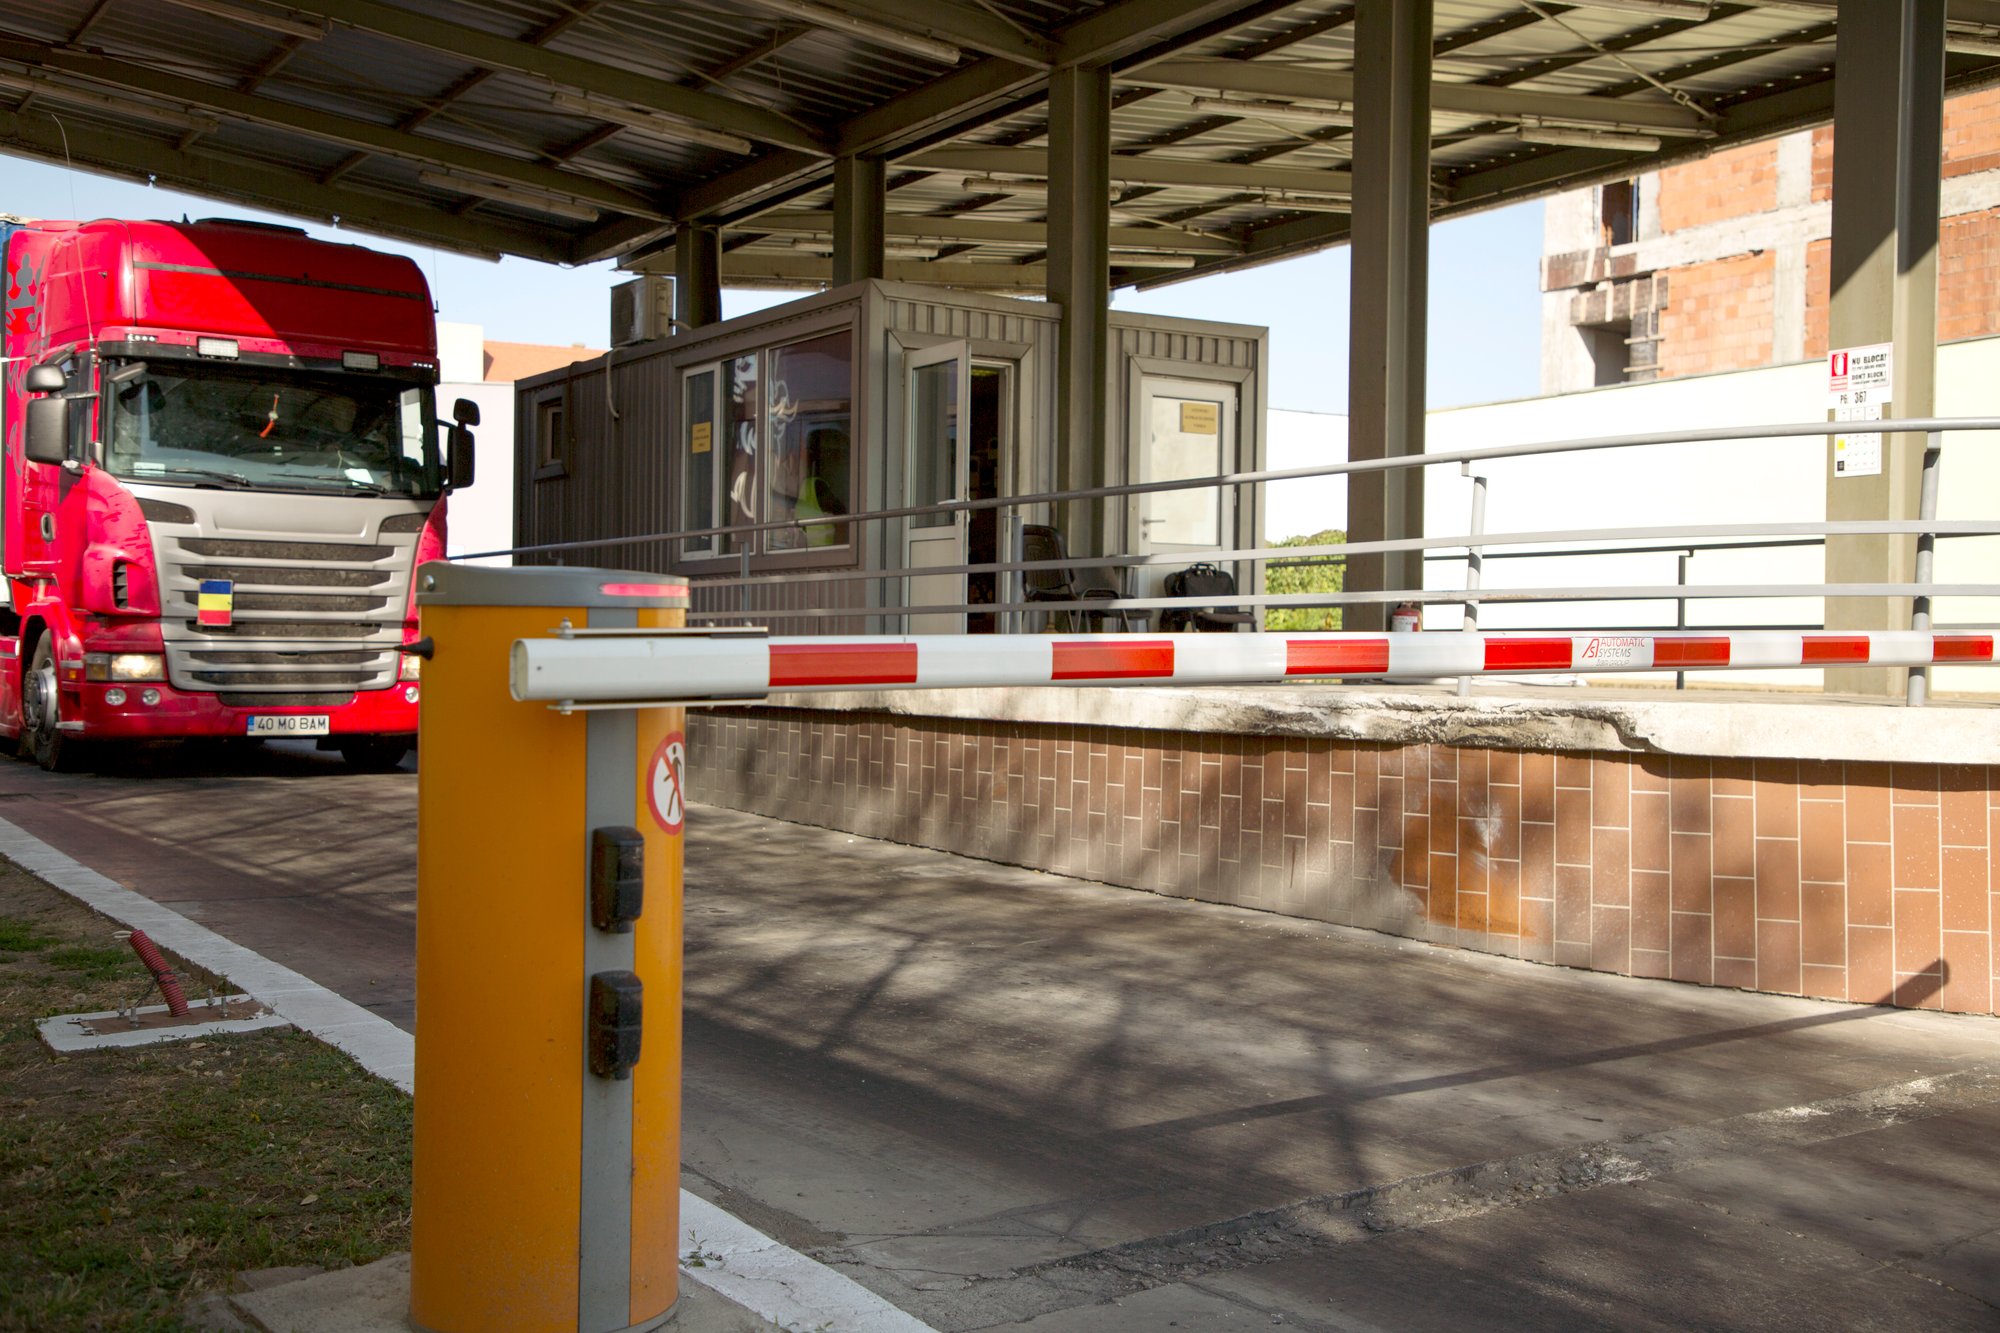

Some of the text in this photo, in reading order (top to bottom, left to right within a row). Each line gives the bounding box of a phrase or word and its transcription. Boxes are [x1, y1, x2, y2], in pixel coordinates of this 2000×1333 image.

[1852, 357, 1861, 365] NU
[1855, 391, 1867, 404] 367
[1600, 638, 1645, 648] AUTOMATIC
[1598, 648, 1632, 658] SYSTEMS
[258, 718, 326, 730] 40 MO BAM
